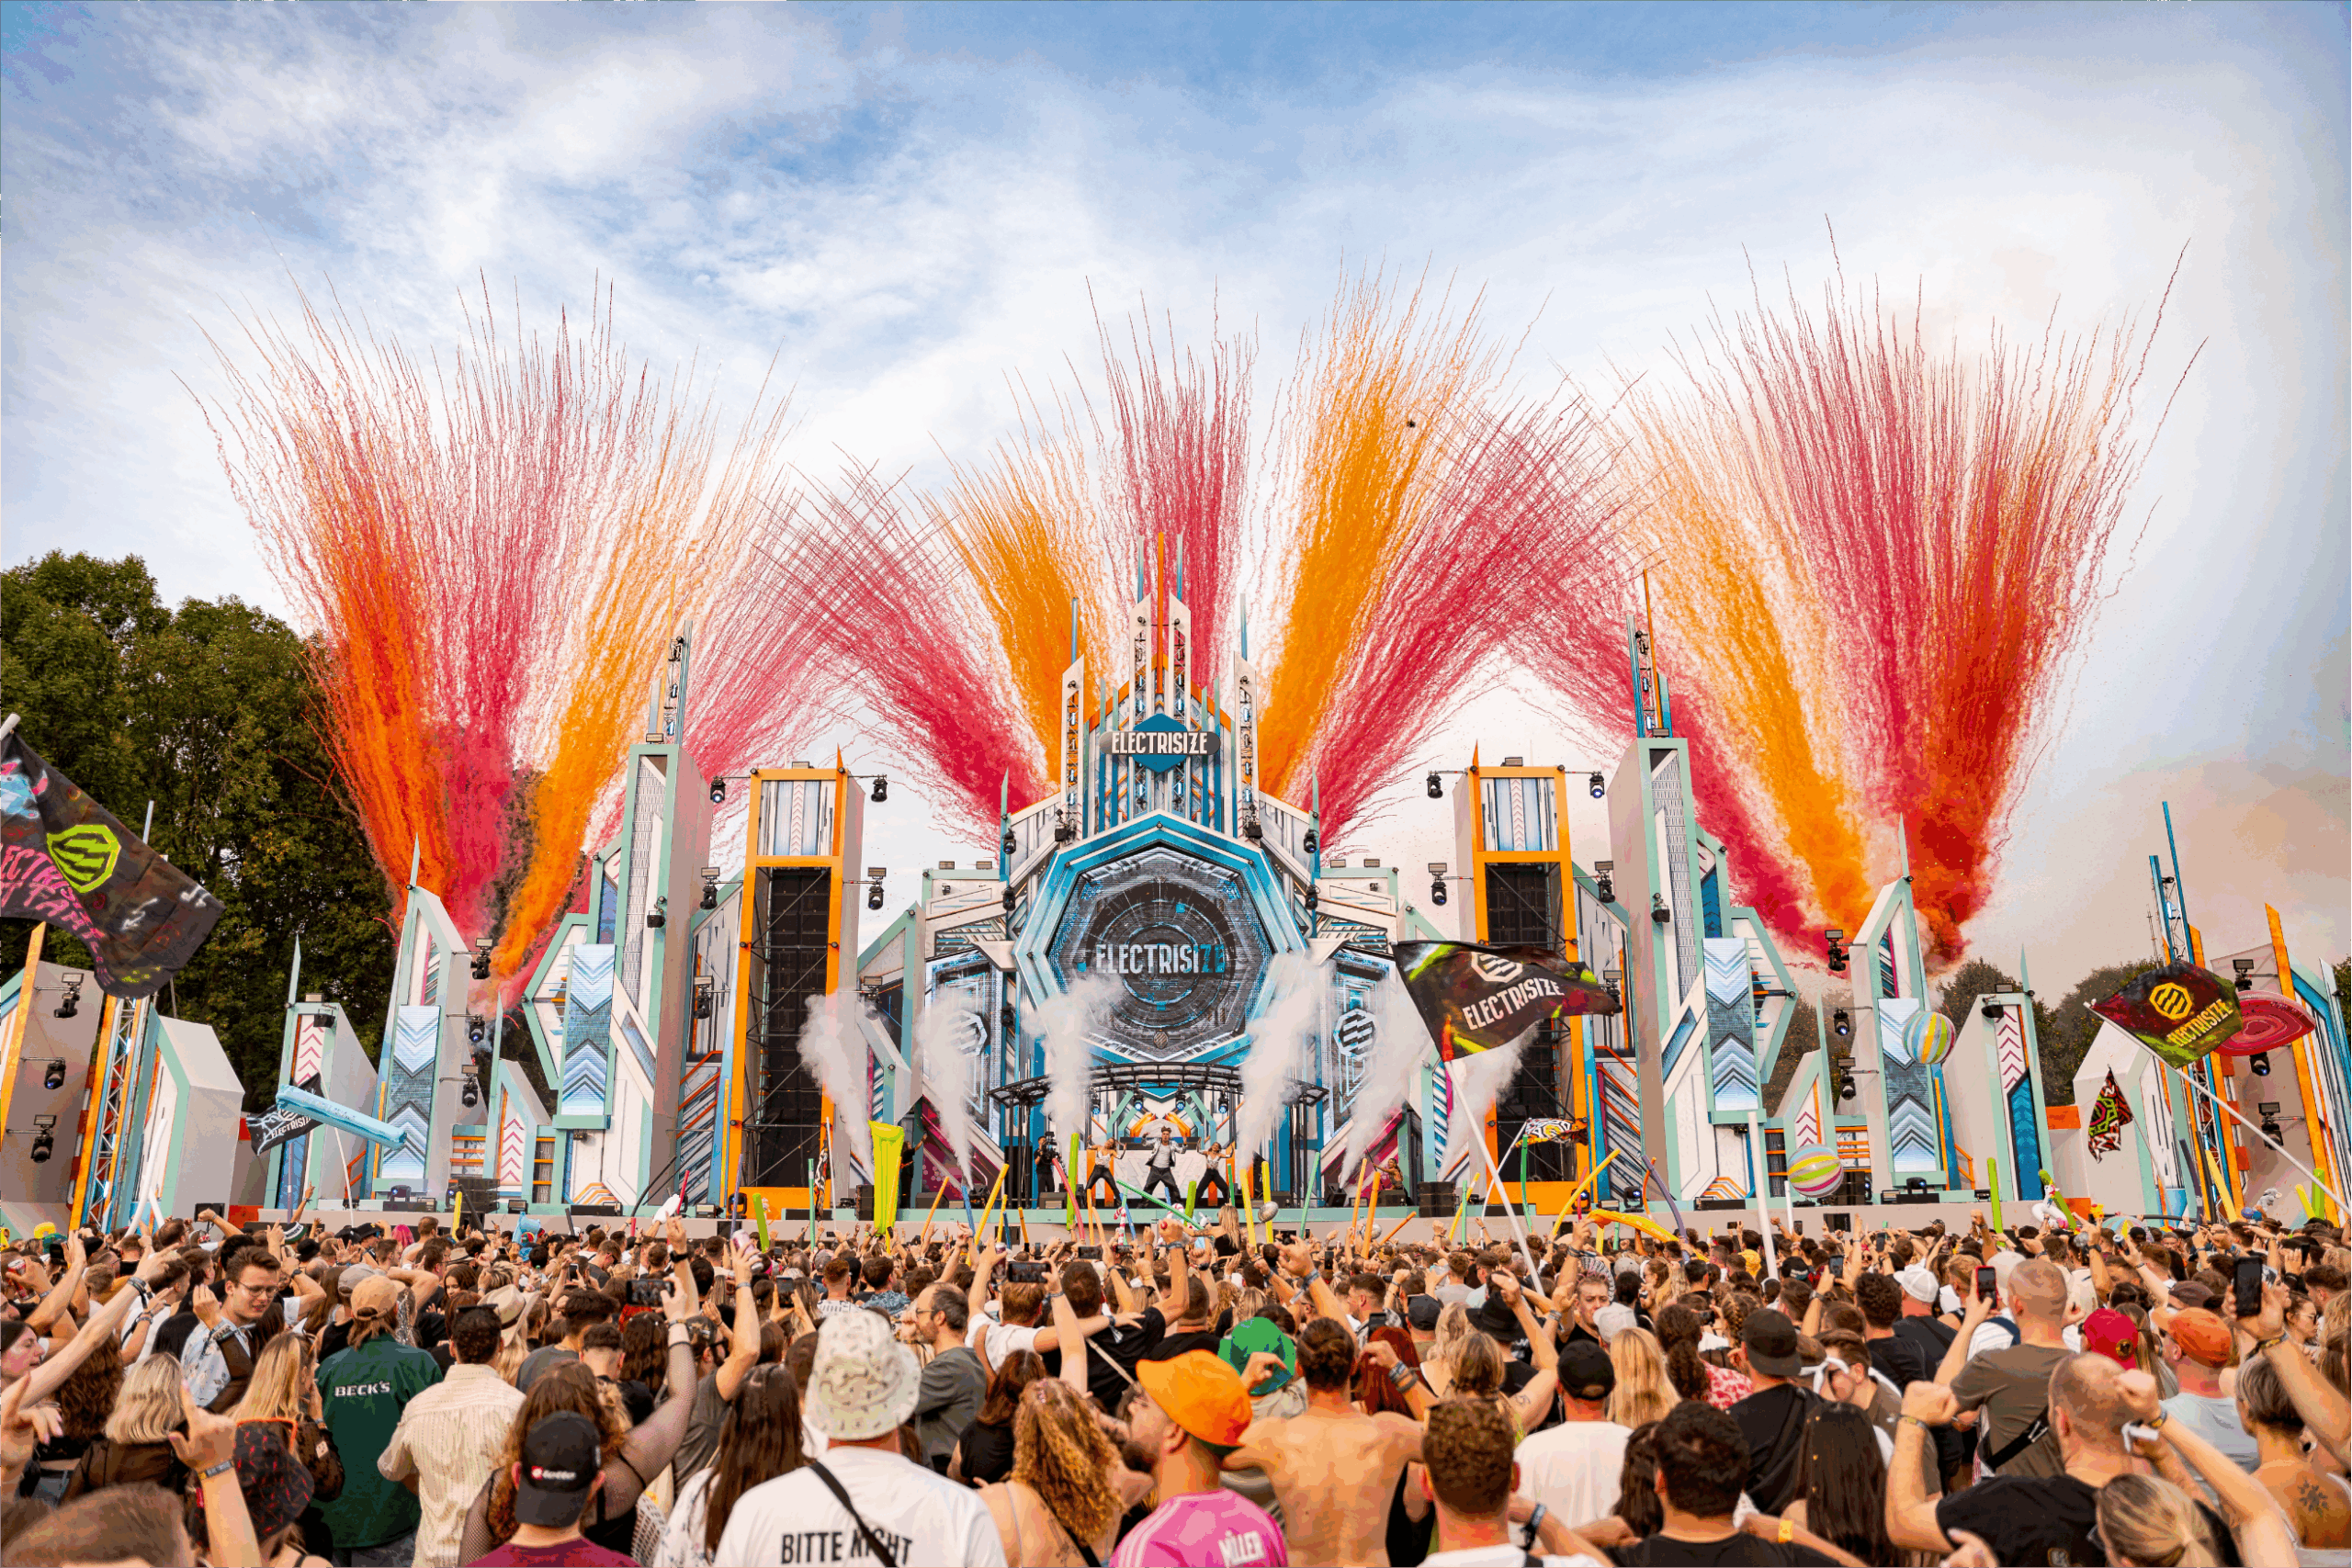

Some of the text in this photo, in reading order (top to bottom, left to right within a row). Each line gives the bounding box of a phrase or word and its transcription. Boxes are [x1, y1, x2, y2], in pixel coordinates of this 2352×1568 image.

[1112, 732, 1208, 754] ELECTRISIZE
[1096, 943, 1226, 974] ELECTRISIZE
[1462, 977, 1566, 1031] ELECTRISIZE
[334, 1380, 390, 1397] BECK'S
[781, 1531, 842, 1564] BITTE
